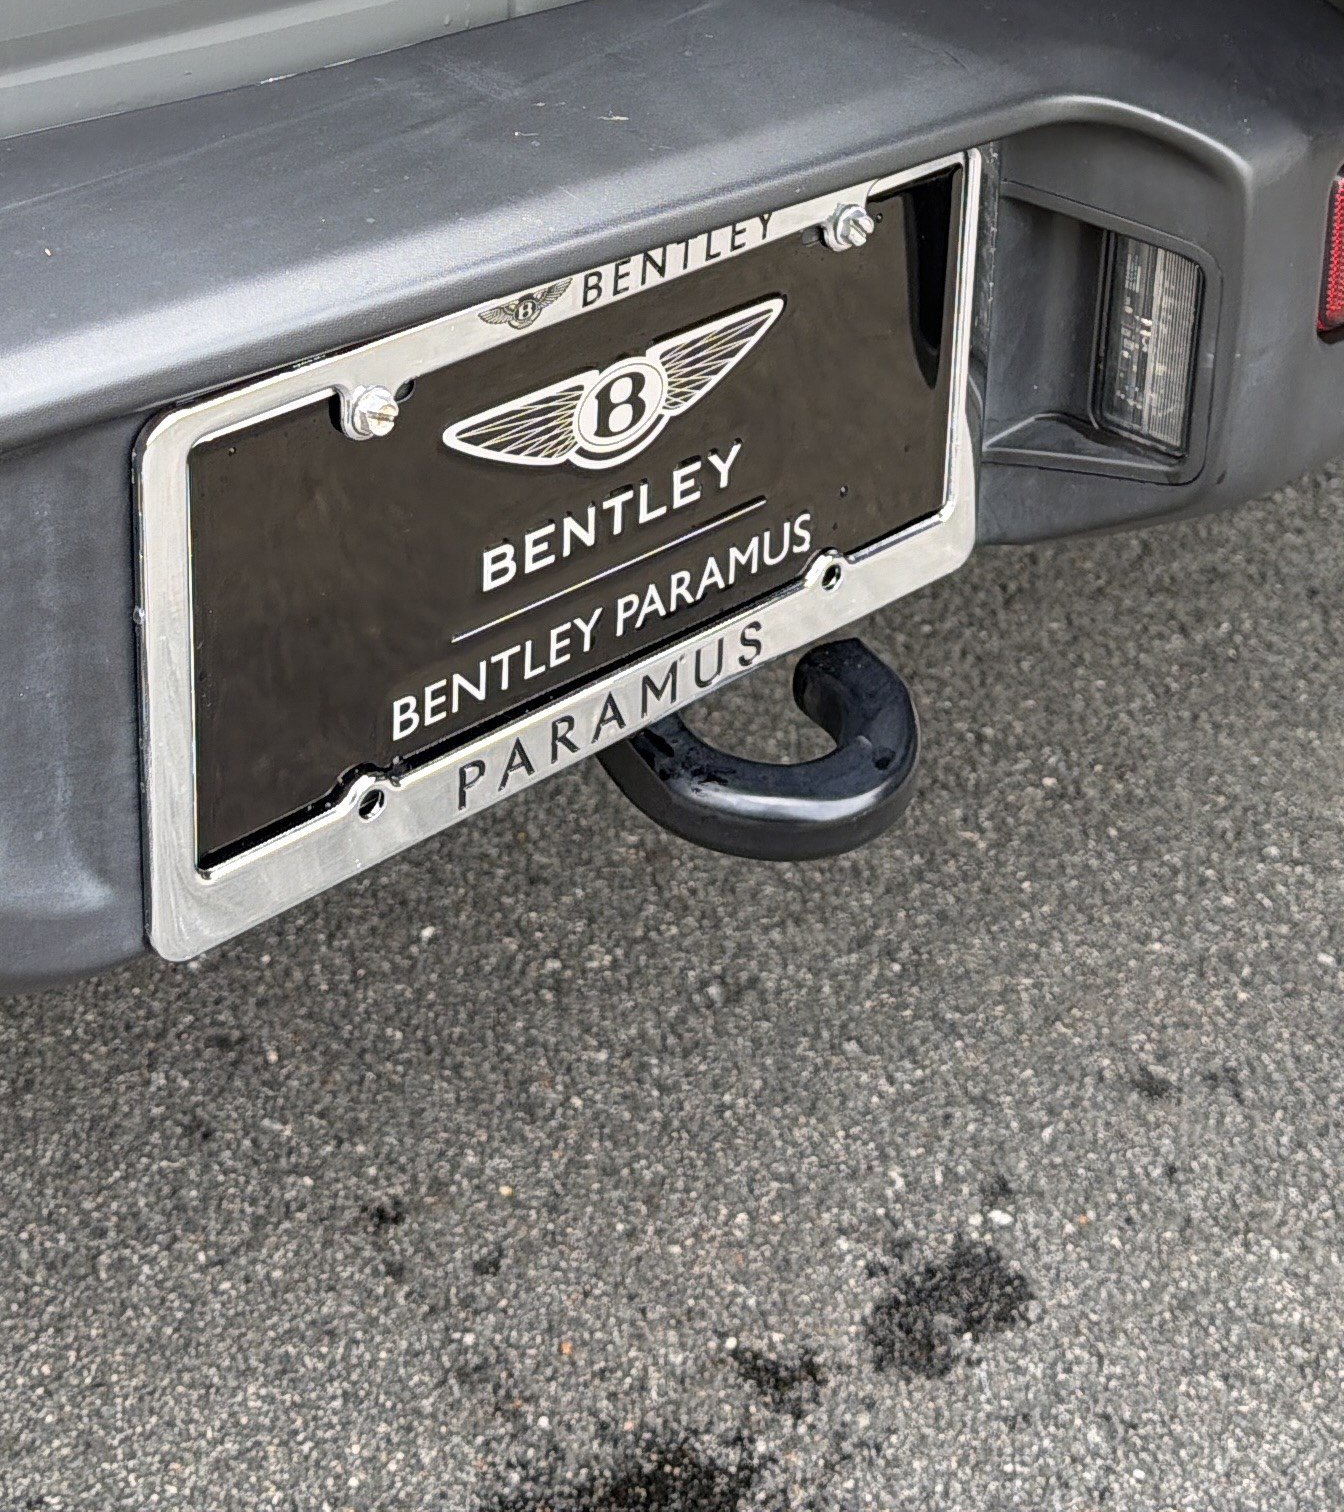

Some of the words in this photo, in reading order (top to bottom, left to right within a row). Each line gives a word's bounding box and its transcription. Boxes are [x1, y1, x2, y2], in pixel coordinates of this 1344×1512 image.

[581, 211, 774, 309] BENTLEY
[481, 442, 743, 593] BENTLEY
[391, 606, 603, 742] BENTLEY
[616, 512, 812, 650] PARAMUS
[456, 620, 765, 812] PARAMUS
